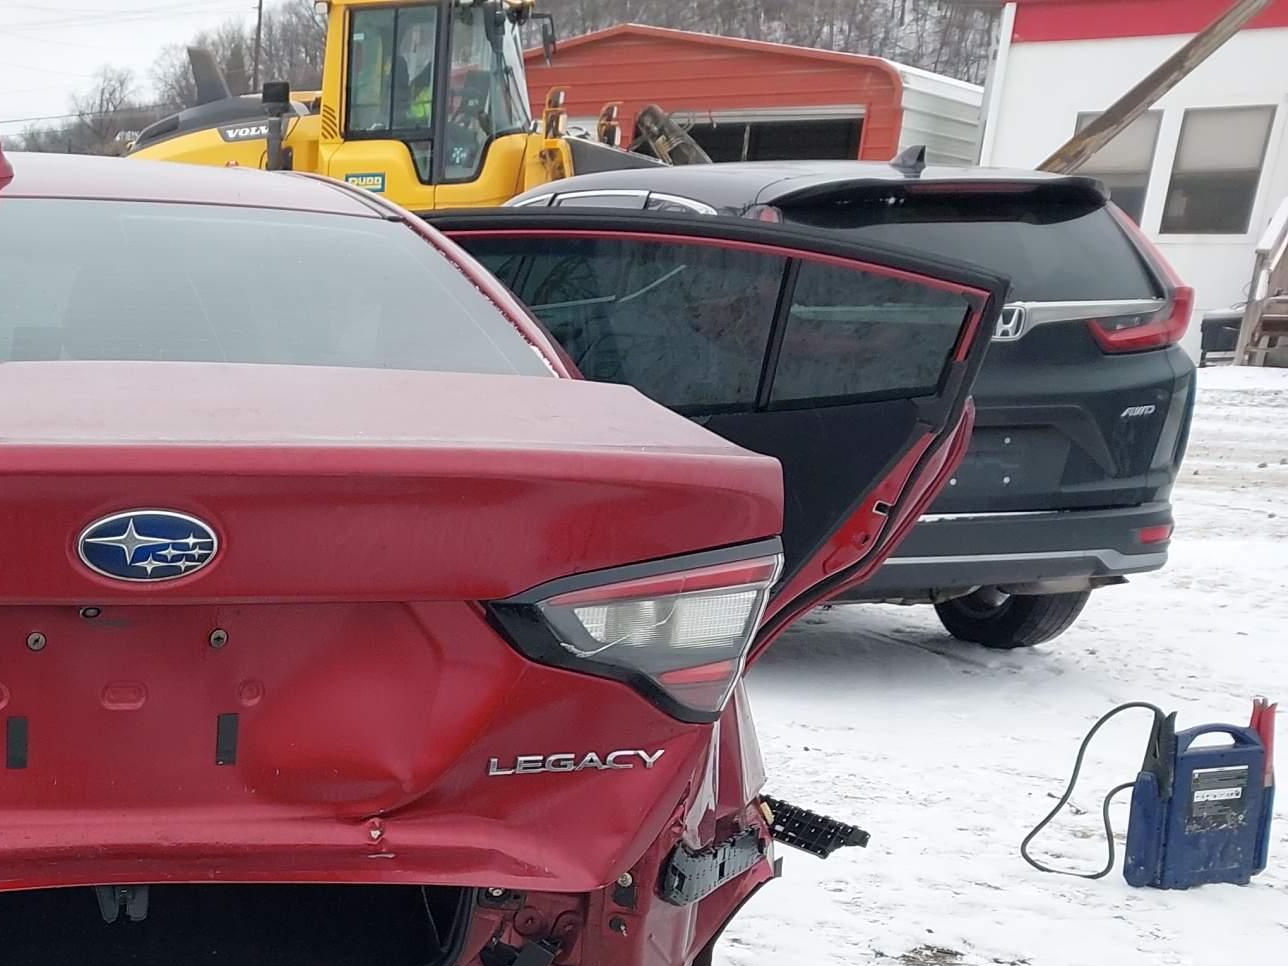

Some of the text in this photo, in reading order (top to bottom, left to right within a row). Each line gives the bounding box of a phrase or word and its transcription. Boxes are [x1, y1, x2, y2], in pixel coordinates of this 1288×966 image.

[226, 126, 269, 138] VOLV
[1120, 404, 1156, 417] AWD
[488, 749, 665, 776] LEGACY
